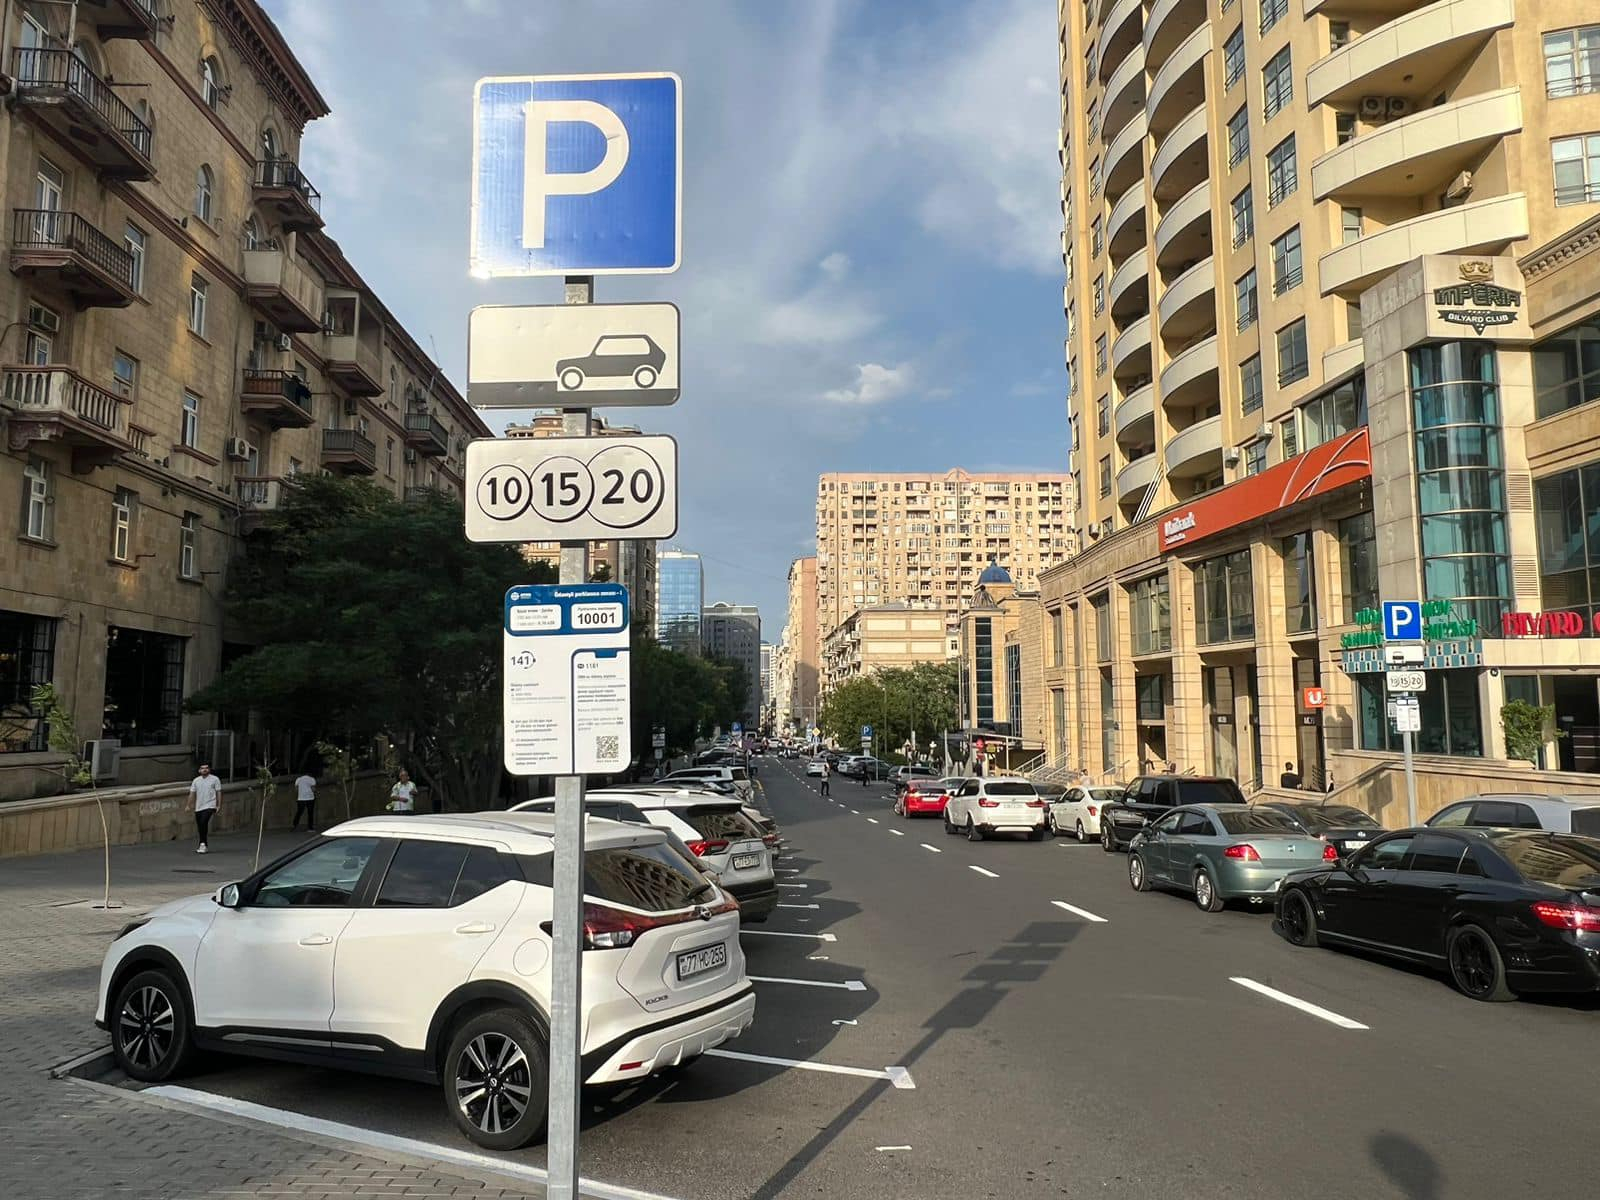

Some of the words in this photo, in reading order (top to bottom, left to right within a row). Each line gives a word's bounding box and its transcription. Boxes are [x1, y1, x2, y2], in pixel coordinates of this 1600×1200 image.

[522, 100, 630, 248] P
[1433, 282, 1521, 307] IMPERIA
[1447, 312, 1484, 323] BILYARD
[1485, 314, 1509, 322] CLUB
[486, 476, 522, 505] 10
[541, 471, 581, 507] 15
[602, 468, 654, 504] 20
[577, 612, 615, 625] 10001
[1391, 605, 1413, 636] P
[511, 656, 530, 666] 141
[1400, 677, 1409, 685] 15
[1411, 676, 1421, 685] 20
